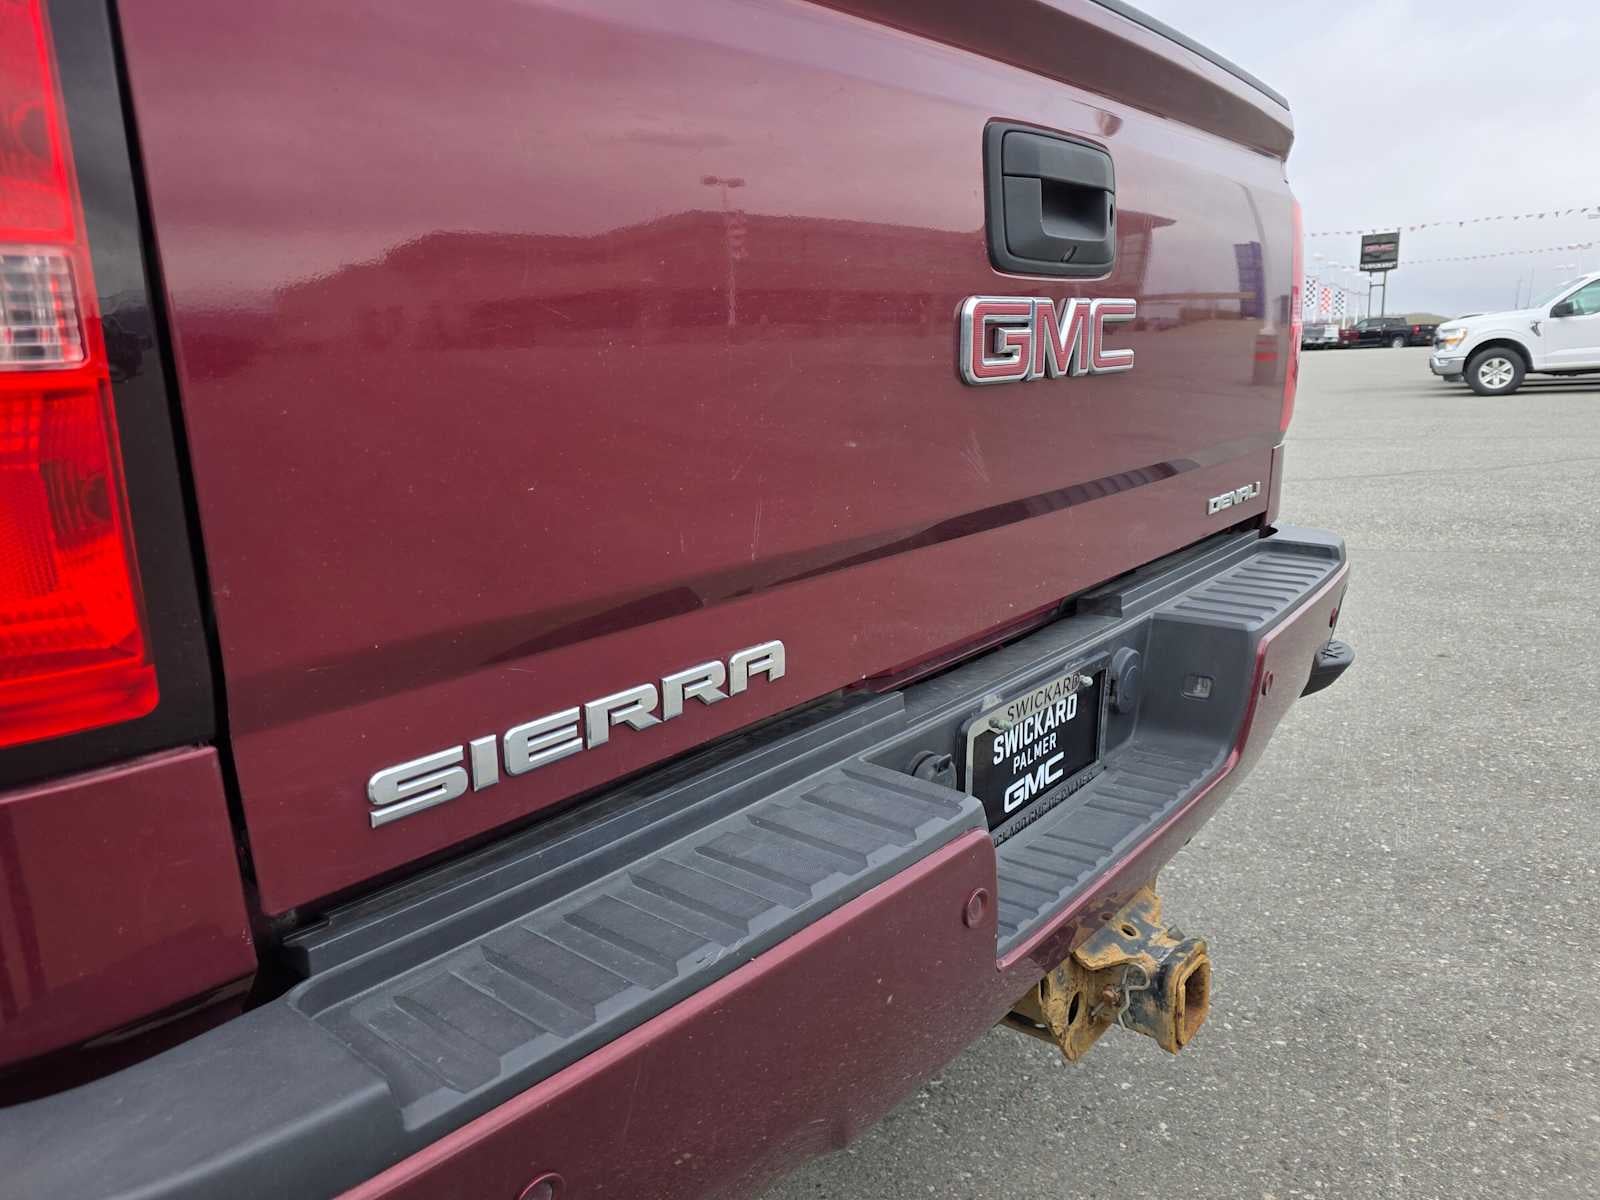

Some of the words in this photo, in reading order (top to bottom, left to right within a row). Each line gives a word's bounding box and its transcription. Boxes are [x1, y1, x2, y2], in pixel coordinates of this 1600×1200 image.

[960, 296, 1137, 385] GMC
[1208, 481, 1261, 516] DENALI
[1007, 672, 1081, 722] SWICKARD
[367, 639, 786, 829] SIERRA
[993, 693, 1078, 765] SWICKARD
[1013, 732, 1057, 775] PALMER
[1004, 751, 1064, 814] GMC
